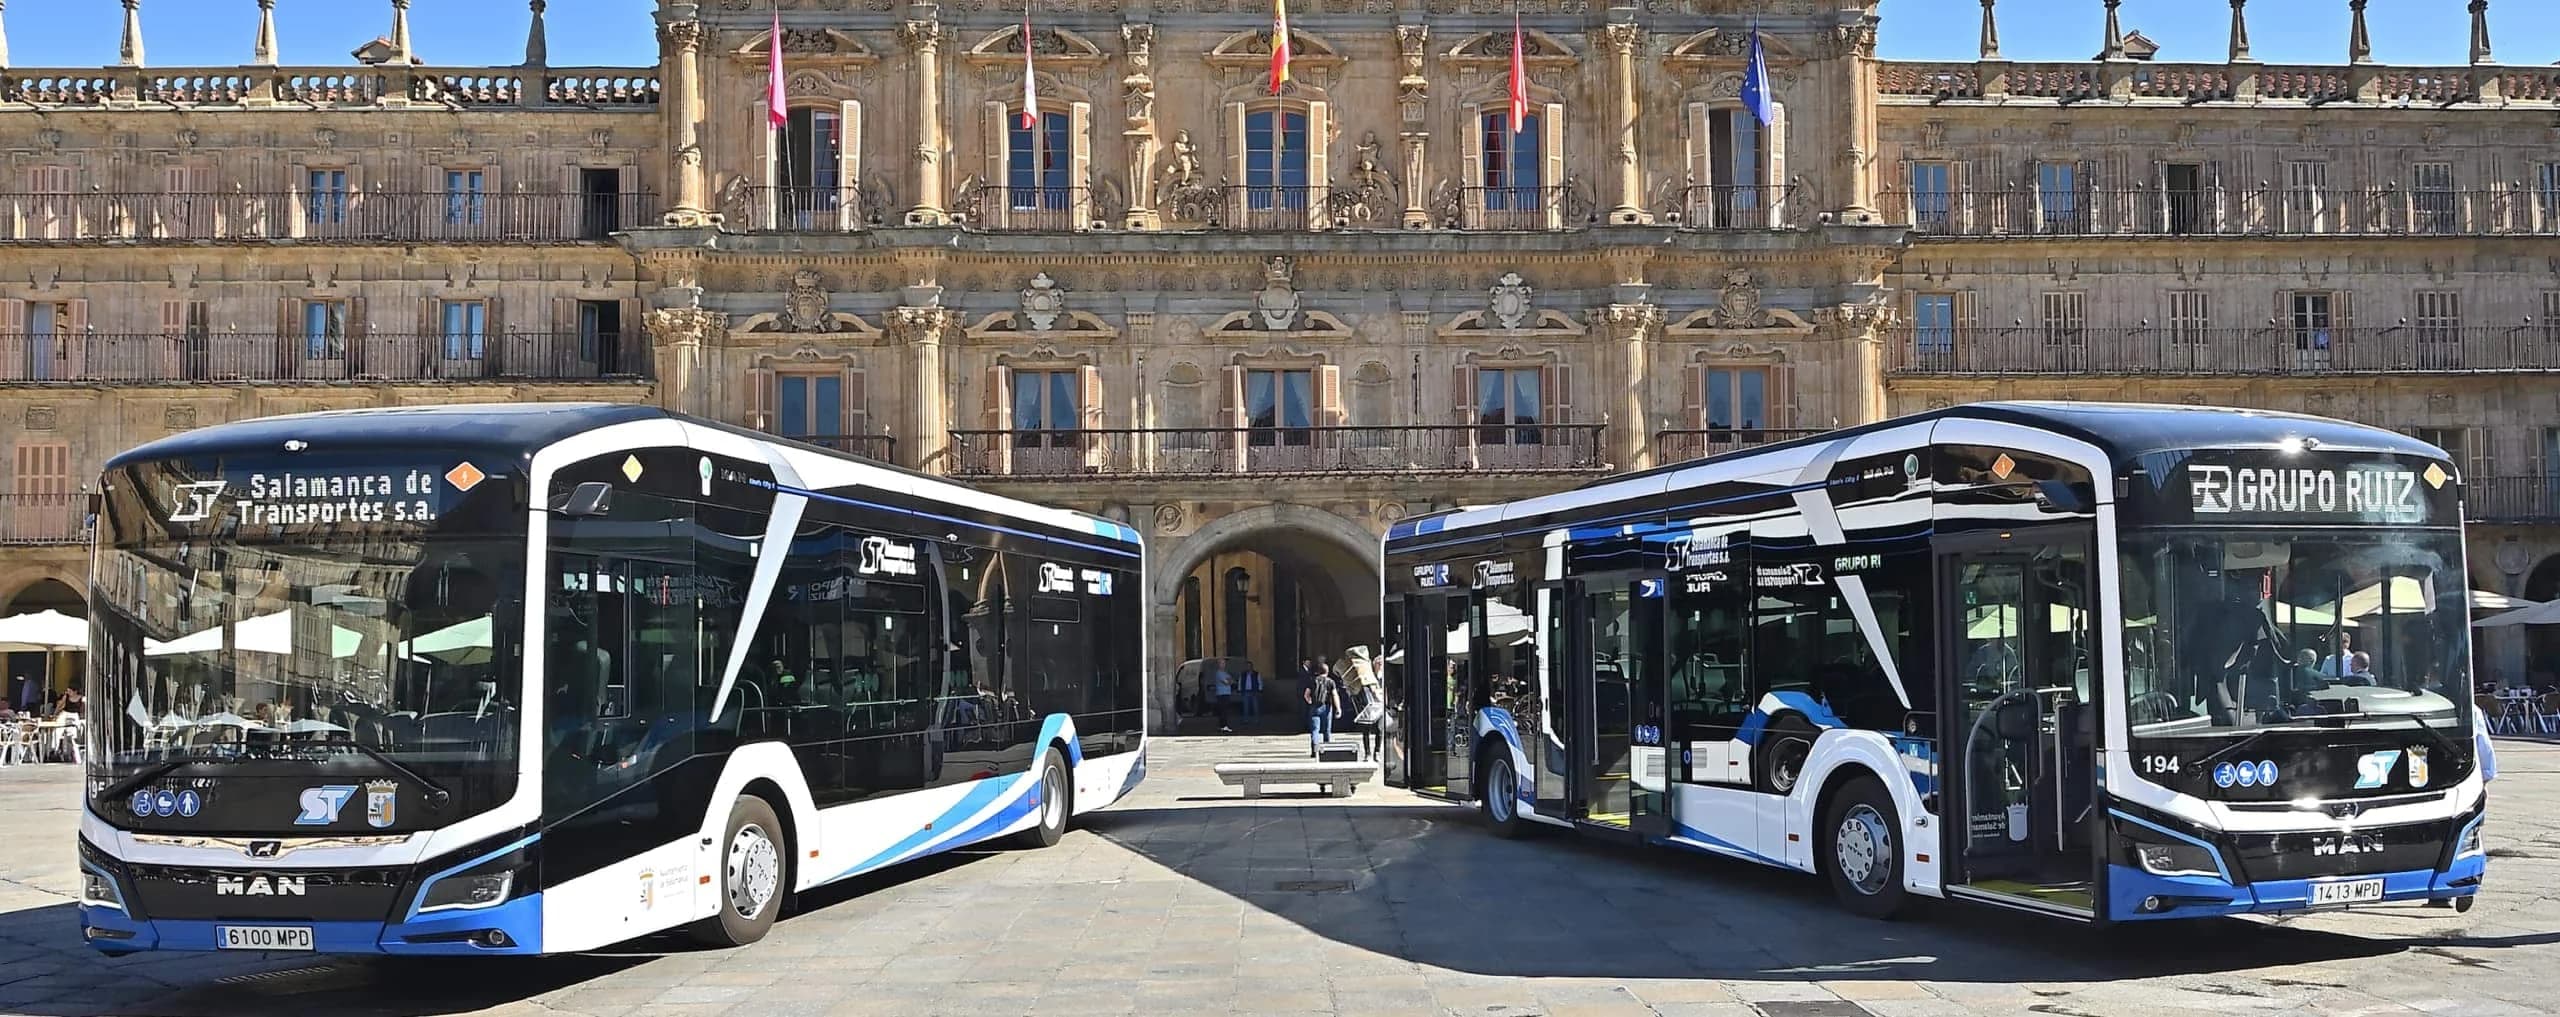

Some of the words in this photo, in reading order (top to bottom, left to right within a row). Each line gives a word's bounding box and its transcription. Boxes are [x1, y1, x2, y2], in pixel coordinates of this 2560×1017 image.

[250, 473, 393, 499] Salamanca
[405, 470, 432, 495] de
[1863, 465, 1894, 480] MAN
[169, 480, 228, 521] ST
[2238, 468, 2335, 512] GRUPO
[2346, 470, 2415, 513] RUIZ
[236, 498, 384, 525] Transportes
[394, 500, 436, 522] s.a.
[859, 536, 889, 574] ST
[1834, 557, 1868, 571] GRUPO
[2142, 755, 2180, 774] 194
[2354, 750, 2402, 789] ST
[294, 785, 359, 824] ST
[2312, 834, 2385, 856] MAN
[216, 876, 306, 896] MAN
[2319, 885, 2351, 902] 1413
[2354, 882, 2381, 898] MPD
[229, 930, 272, 946] 6100
[277, 930, 309, 947] MPD
